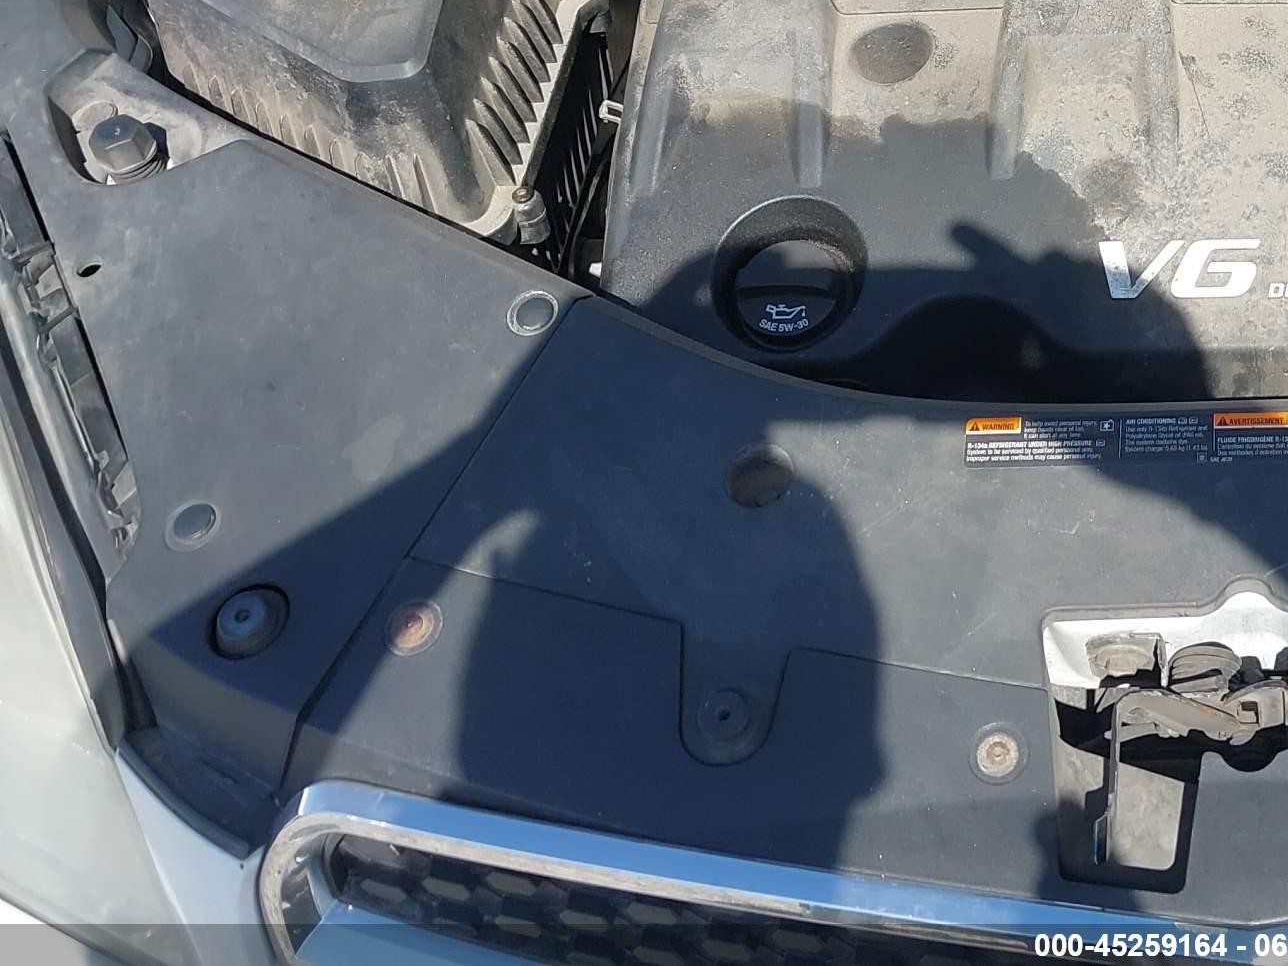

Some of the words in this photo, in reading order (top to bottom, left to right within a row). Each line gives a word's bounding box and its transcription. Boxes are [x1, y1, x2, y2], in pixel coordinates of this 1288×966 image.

[1098, 238, 1261, 299] V6
[759, 319, 778, 331] SAE
[778, 319, 809, 332] 5W-30
[982, 423, 1015, 431] WARNING
[1230, 418, 1284, 426] AVERTISSEMENT
